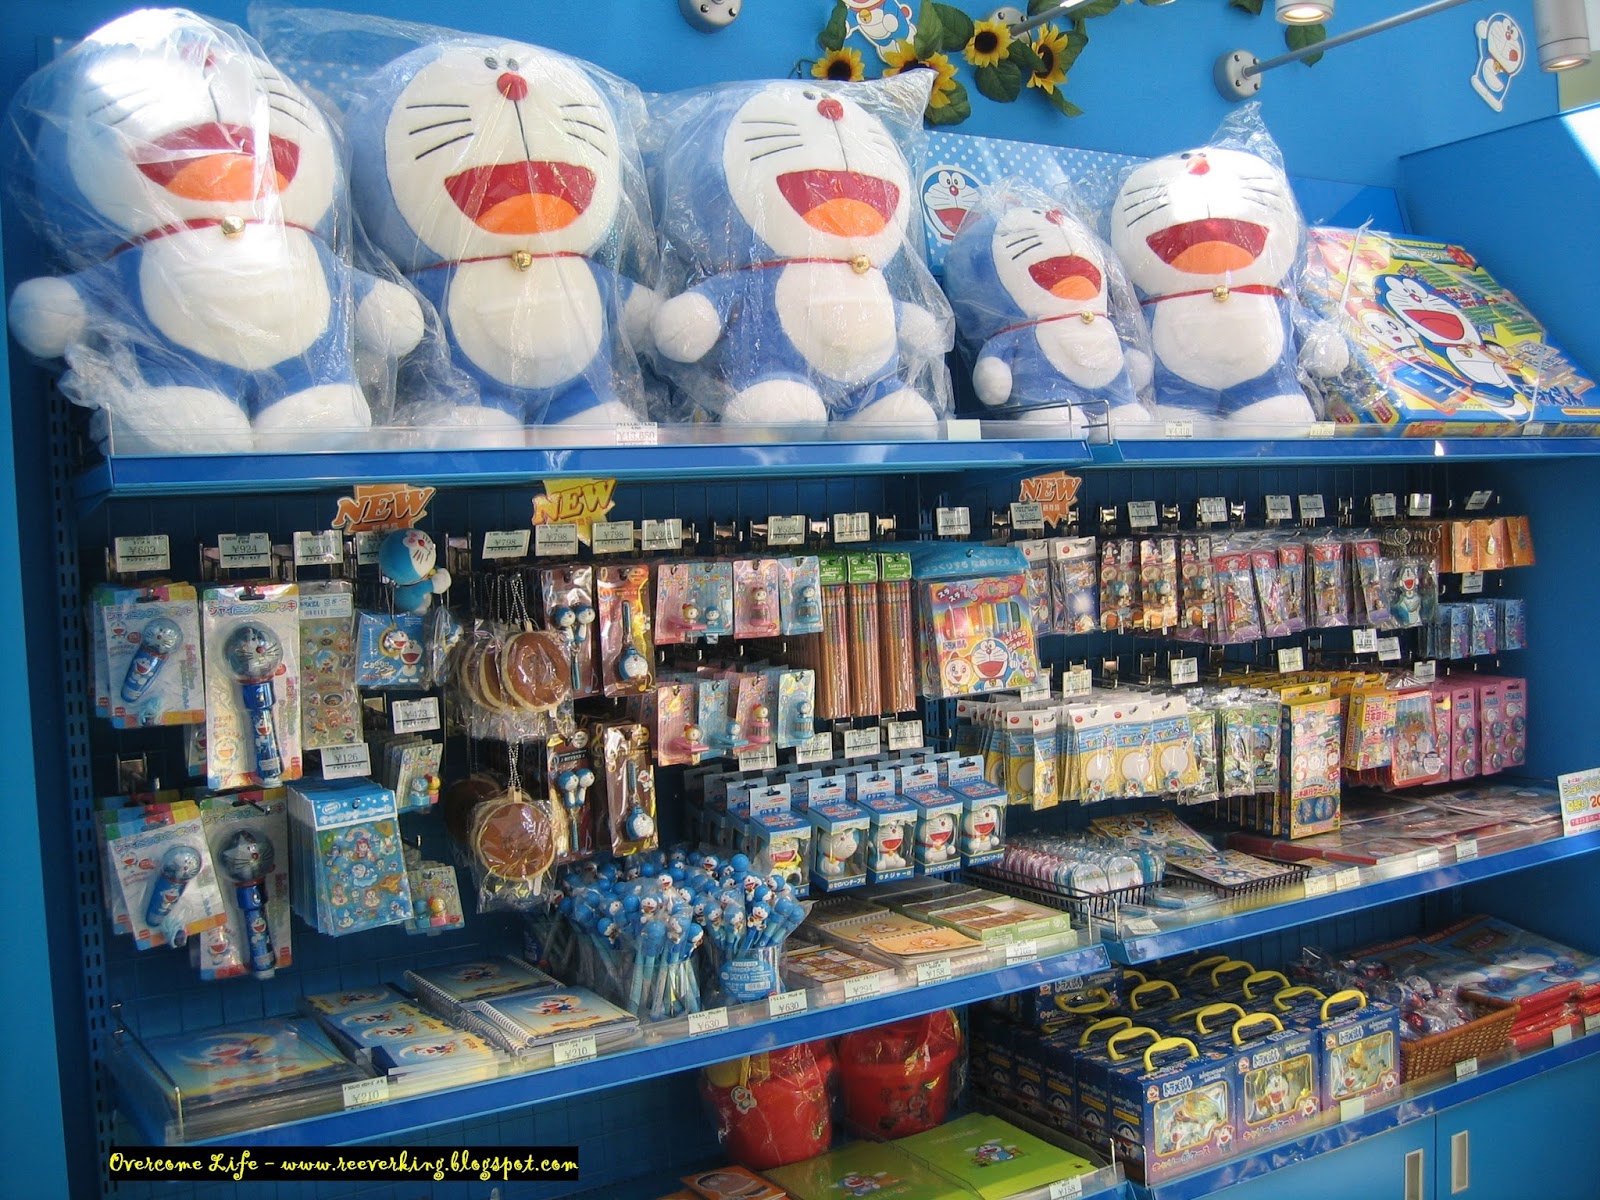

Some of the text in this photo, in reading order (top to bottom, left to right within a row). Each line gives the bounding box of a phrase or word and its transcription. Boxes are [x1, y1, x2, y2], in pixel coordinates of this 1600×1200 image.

[1019, 477, 1082, 502] NEW
[332, 487, 436, 527] NEW
[532, 479, 617, 526] NEW
[546, 532, 568, 541] ¥798
[603, 530, 624, 539] ¥798
[494, 538, 517, 546] ¥798
[232, 545, 257, 554] ¥924
[335, 753, 358, 762] ¥126
[883, 871, 906, 881] メジャー
[833, 879, 862, 889] セロハンテープ
[779, 1002, 799, 1012] ¥630
[698, 1019, 719, 1030] ¥630
[565, 1047, 588, 1059] ¥210
[352, 1090, 380, 1103] ¥210
